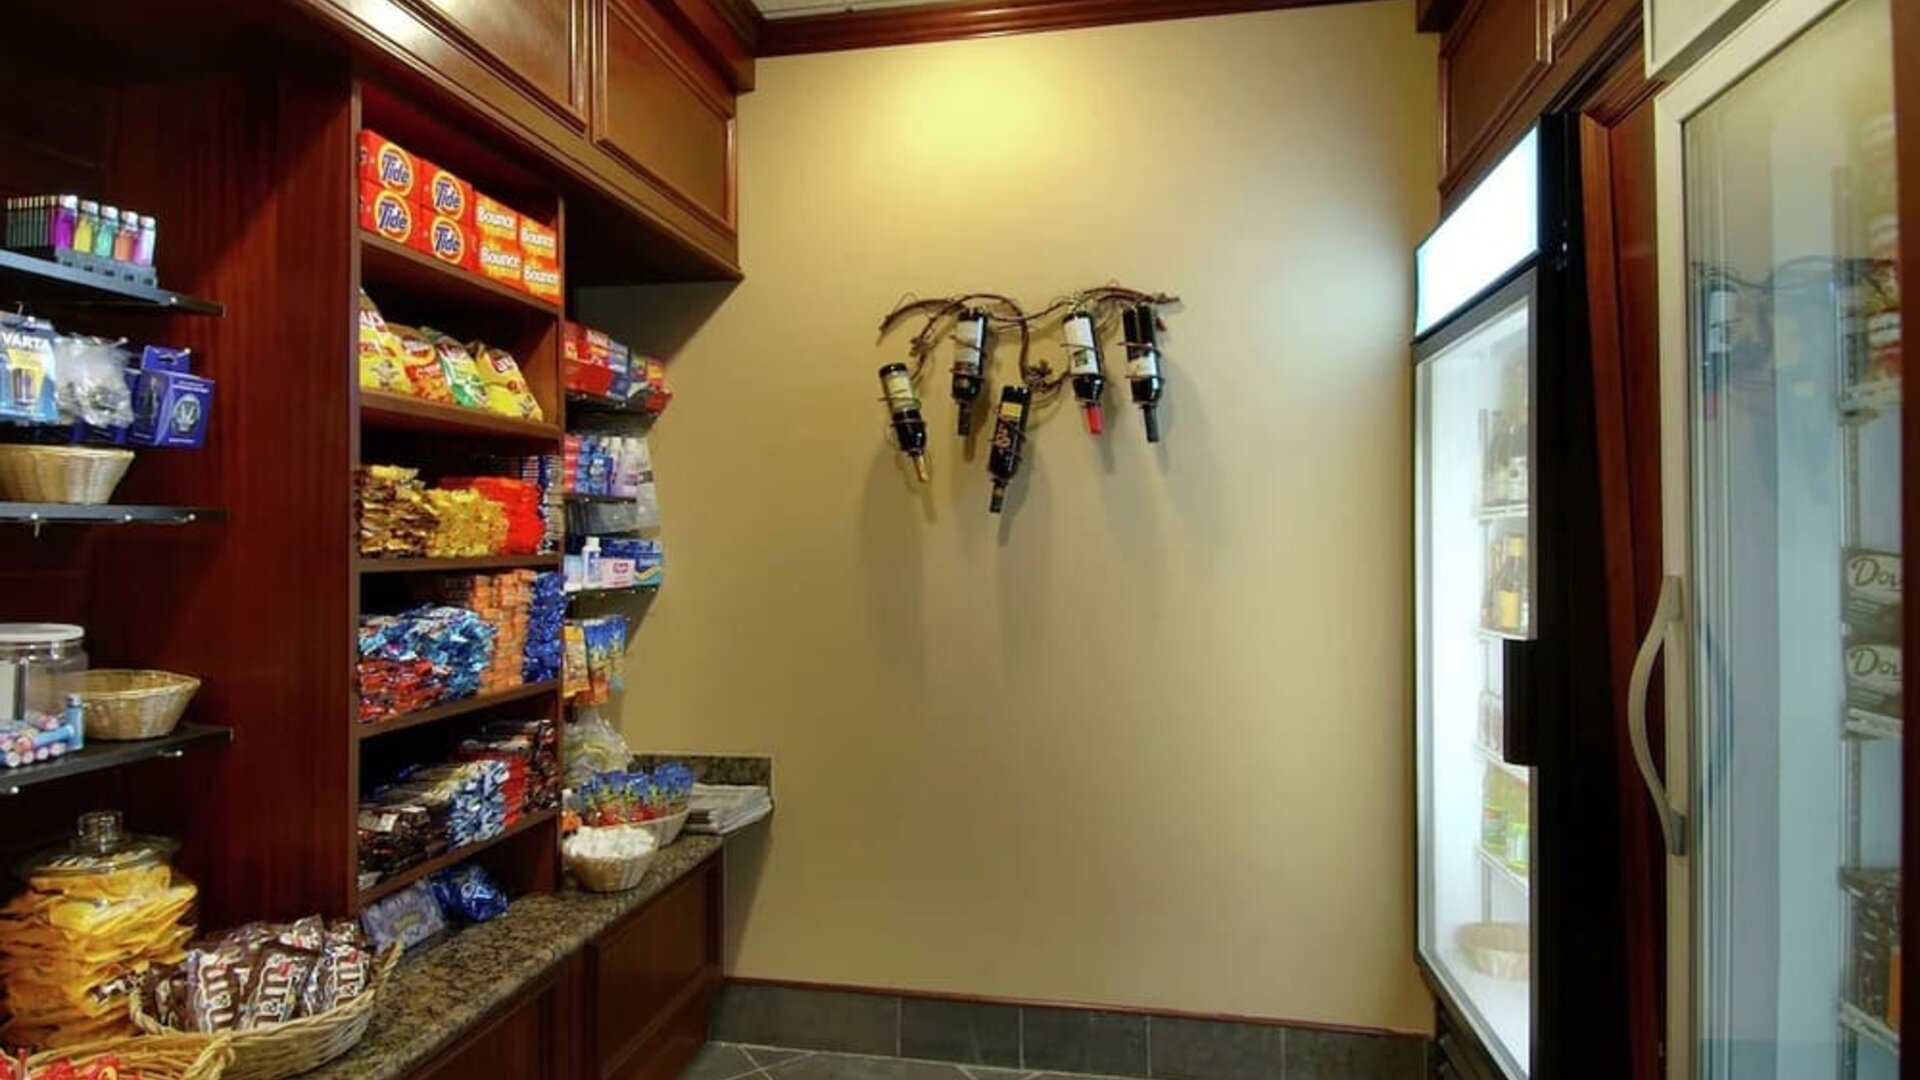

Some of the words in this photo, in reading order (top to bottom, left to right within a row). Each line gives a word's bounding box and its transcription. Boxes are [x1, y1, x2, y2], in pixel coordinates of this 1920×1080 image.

[382, 152, 411, 183] Tide
[436, 181, 461, 209] Tide
[379, 200, 408, 230] Tide
[476, 205, 514, 229] Bounce
[435, 225, 461, 253] Tide
[520, 226, 555, 249] Bounce
[480, 245, 522, 270] Bounce
[524, 265, 560, 287] Bounce
[0, 331, 50, 351] VARTA
